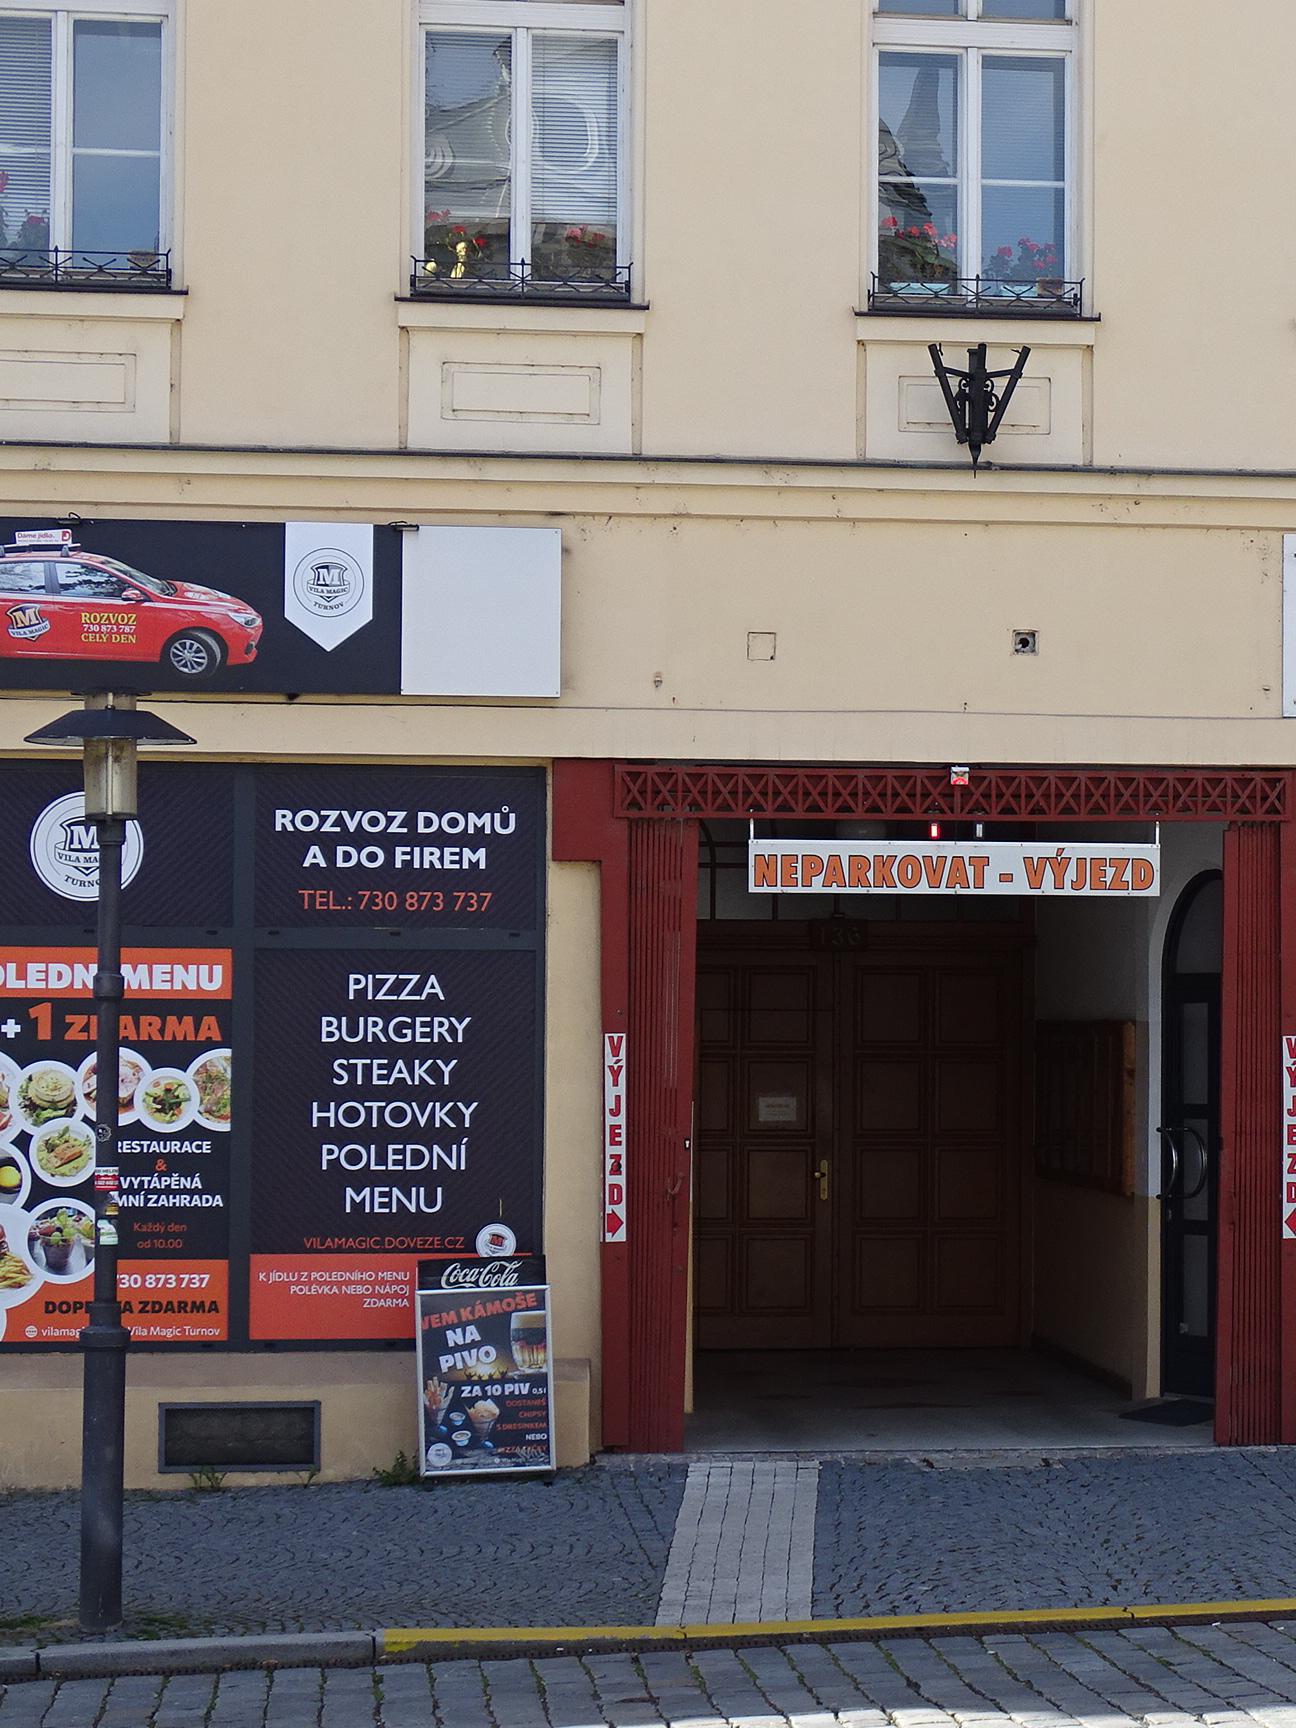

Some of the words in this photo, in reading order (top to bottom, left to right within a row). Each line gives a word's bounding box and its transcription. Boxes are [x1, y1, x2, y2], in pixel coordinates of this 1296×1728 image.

[81, 612, 137, 625] ROZVOZ
[83, 624, 100, 632] 730
[111, 634, 137, 643] DEN
[275, 810, 408, 833] ROZVOZ
[417, 805, 516, 835] DOMŮ
[57, 851, 81, 863] VILA
[303, 845, 327, 868] A
[336, 846, 385, 869] DO
[394, 847, 487, 870] FIREM
[753, 854, 990, 889] NEPARKOVAT
[1023, 848, 1155, 891] VÝJEZD
[298, 890, 353, 911] TEL.:
[357, 891, 398, 912] 730
[405, 892, 444, 912] 873
[451, 892, 493, 913] 737
[121, 964, 223, 990] MENU
[348, 974, 445, 1001] PIZZA
[320, 1016, 472, 1043] BURGERY
[332, 1058, 458, 1086] STEAKY
[311, 1101, 479, 1128] HOTOVKY
[608, 1035, 624, 1206] VÝJEZD
[321, 1137, 469, 1170] POLEDNÍ
[155, 1159, 168, 1171] &
[120, 1172, 202, 1189] VYTÁPĚNÁ
[147, 1194, 223, 1207] ZAHRADA
[345, 1186, 443, 1213] MENU
[168, 1222, 188, 1232] den
[137, 1239, 151, 1248] od
[303, 1237, 465, 1249] VILAMAGIC.DOVEZE.CZ
[117, 1275, 142, 1288] 30
[145, 1275, 177, 1288] 873
[180, 1275, 210, 1288] 737
[259, 1272, 267, 1281] K
[268, 1269, 298, 1284] JÍDLU
[300, 1272, 309, 1281] Z
[311, 1269, 375, 1281] POLEDNÍHO
[378, 1271, 410, 1281] MENU
[290, 1282, 339, 1295] POLÉVKA
[342, 1285, 372, 1295] NEBO
[375, 1282, 410, 1296] NÁPOJ
[138, 1301, 220, 1314] ZDARMA
[363, 1298, 409, 1308] ZDARMA
[460, 1292, 538, 1321] KÁMOŠE
[150, 1326, 181, 1338] Magic
[184, 1326, 220, 1336] Turnov
[445, 1325, 481, 1347] NA
[439, 1345, 497, 1373] PIVO
[461, 1386, 482, 1397] ZA
[485, 1385, 501, 1396] 10
[504, 1382, 530, 1395] PIV
